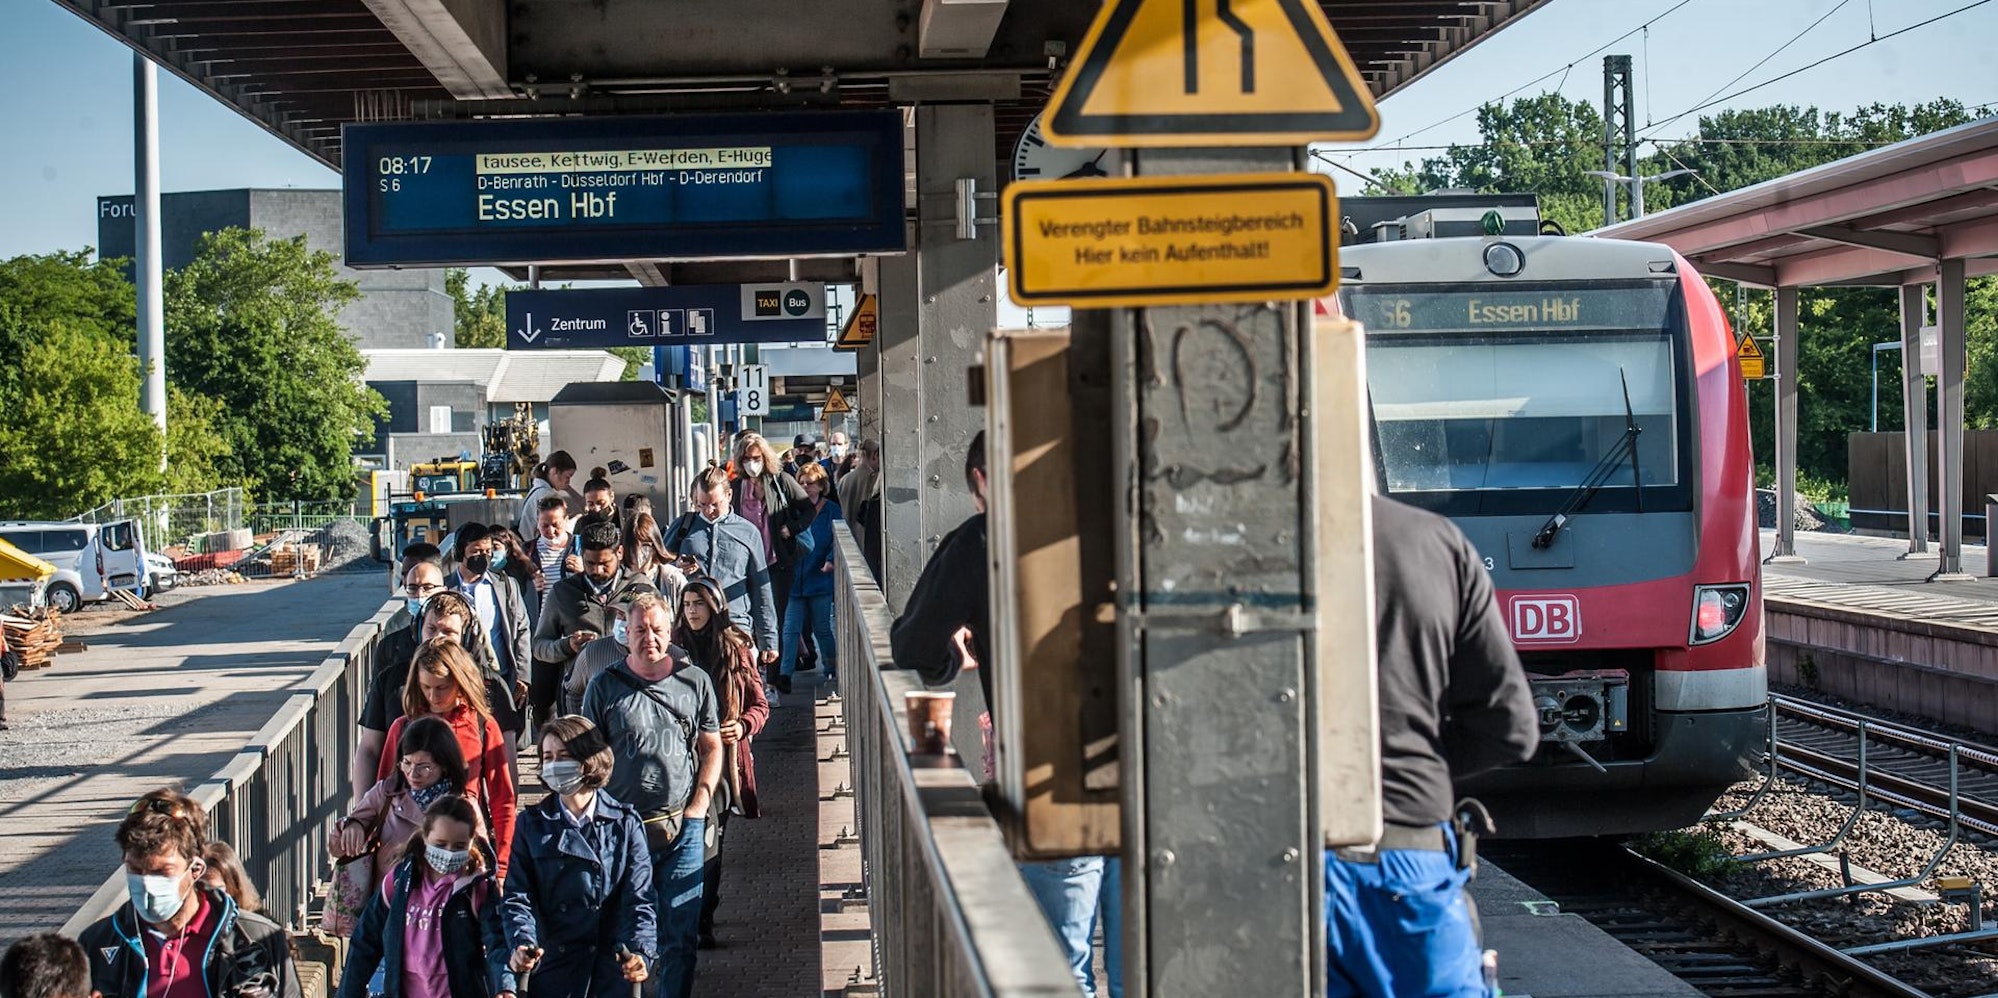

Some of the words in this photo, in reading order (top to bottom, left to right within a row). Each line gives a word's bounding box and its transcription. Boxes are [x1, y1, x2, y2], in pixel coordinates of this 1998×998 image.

[379, 156, 432, 175] 08:17
[484, 154, 546, 170] tausee,
[551, 152, 623, 168] Kettwig,
[628, 150, 713, 166] E-Werden,
[380, 179, 388, 192] S
[392, 178, 401, 192] 6
[478, 174, 547, 190] D-Benrath
[561, 172, 637, 188] Düsseldorf
[641, 170, 666, 186] Hbf
[679, 168, 762, 185] D-Derendorf
[101, 201, 136, 218] Foru
[478, 194, 559, 221] Essen
[571, 191, 617, 219] Hbf
[1039, 219, 1131, 240] Verengter
[1137, 211, 1304, 236] Bahnsteigbereich
[1075, 245, 1113, 265] Hier
[1119, 244, 1160, 263] kein
[1164, 241, 1270, 262] Aufenthalt!
[758, 298, 778, 308] TAXI
[789, 297, 806, 308] Bus
[1468, 300, 1538, 323] Essen
[1542, 297, 1581, 322] Hbf
[1381, 299, 1412, 328] S6
[551, 317, 606, 332] Zentrum
[743, 367, 763, 388] 11
[747, 389, 760, 411] 8
[1519, 603, 1570, 635] DB
